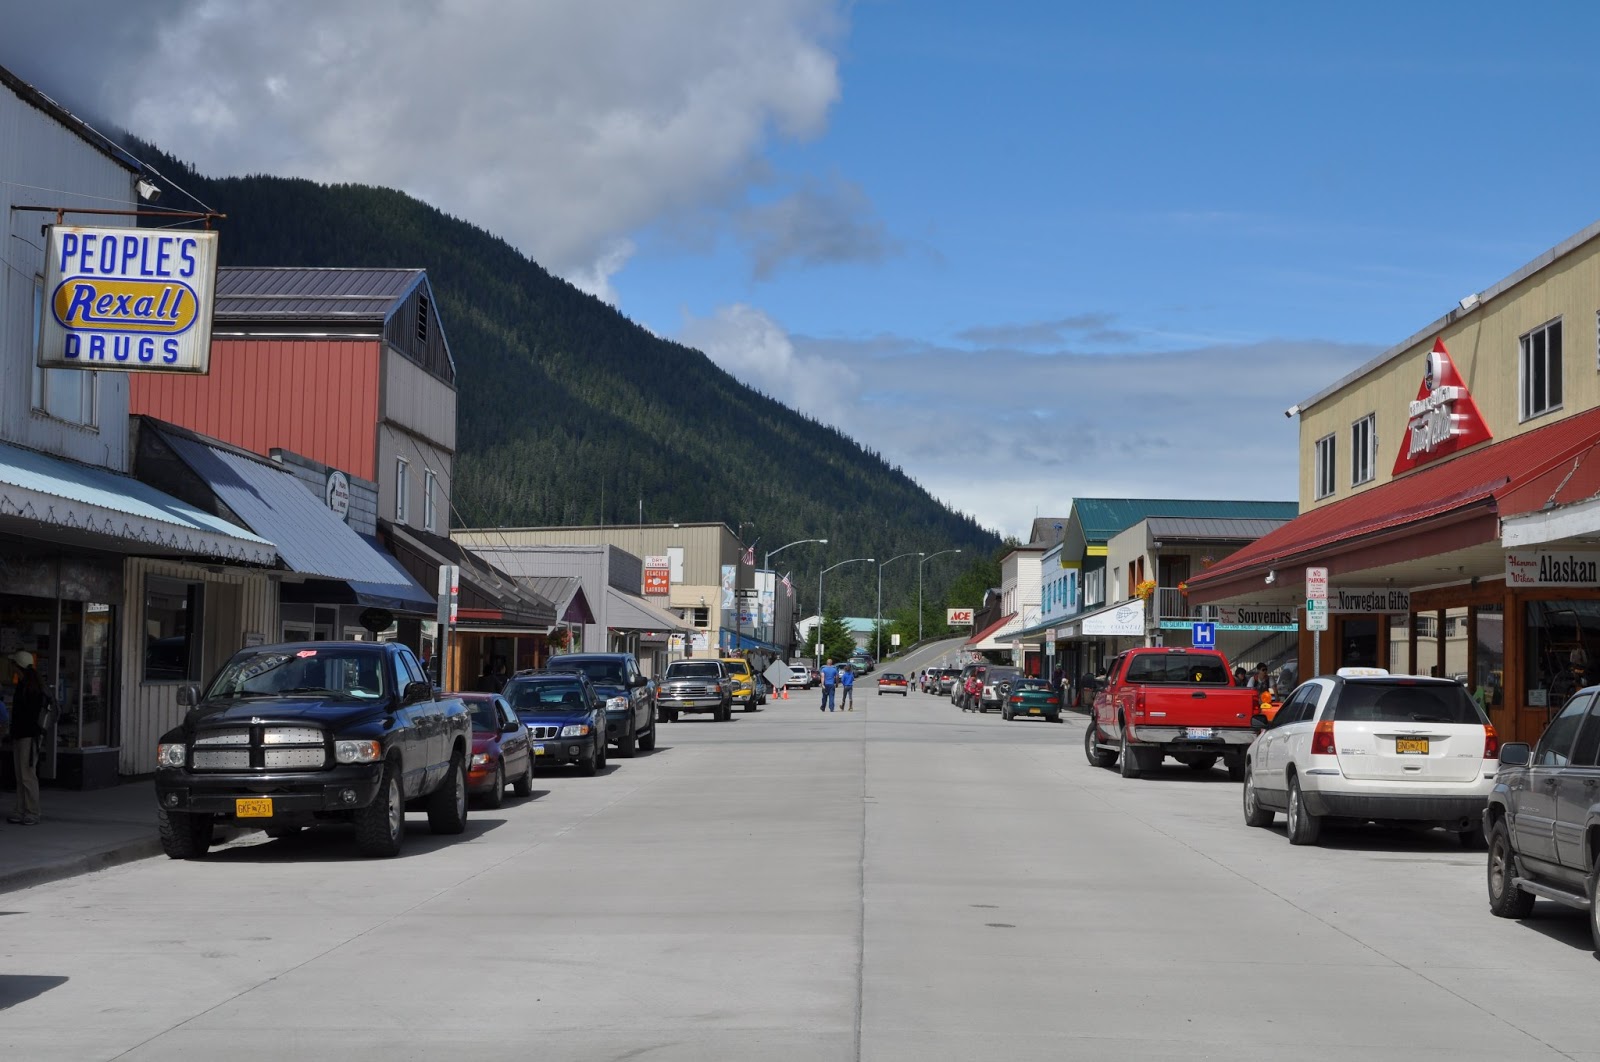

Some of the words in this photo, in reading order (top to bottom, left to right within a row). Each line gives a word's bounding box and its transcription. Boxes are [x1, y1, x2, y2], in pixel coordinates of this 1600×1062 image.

[61, 233, 197, 277] PEOPLE'S
[65, 284, 184, 325] Rexall
[64, 333, 179, 363] DRUGS
[1508, 555, 1537, 567] Hammer
[1539, 555, 1597, 583] Alaskan
[1338, 591, 1386, 611] Norwegian
[1388, 590, 1408, 610] Gifts
[950, 611, 971, 620] ACE
[1238, 608, 1291, 624] Souvenirs
[1197, 626, 1210, 642] H
[1398, 742, 1411, 750] GNG
[1415, 742, 1427, 750] 211
